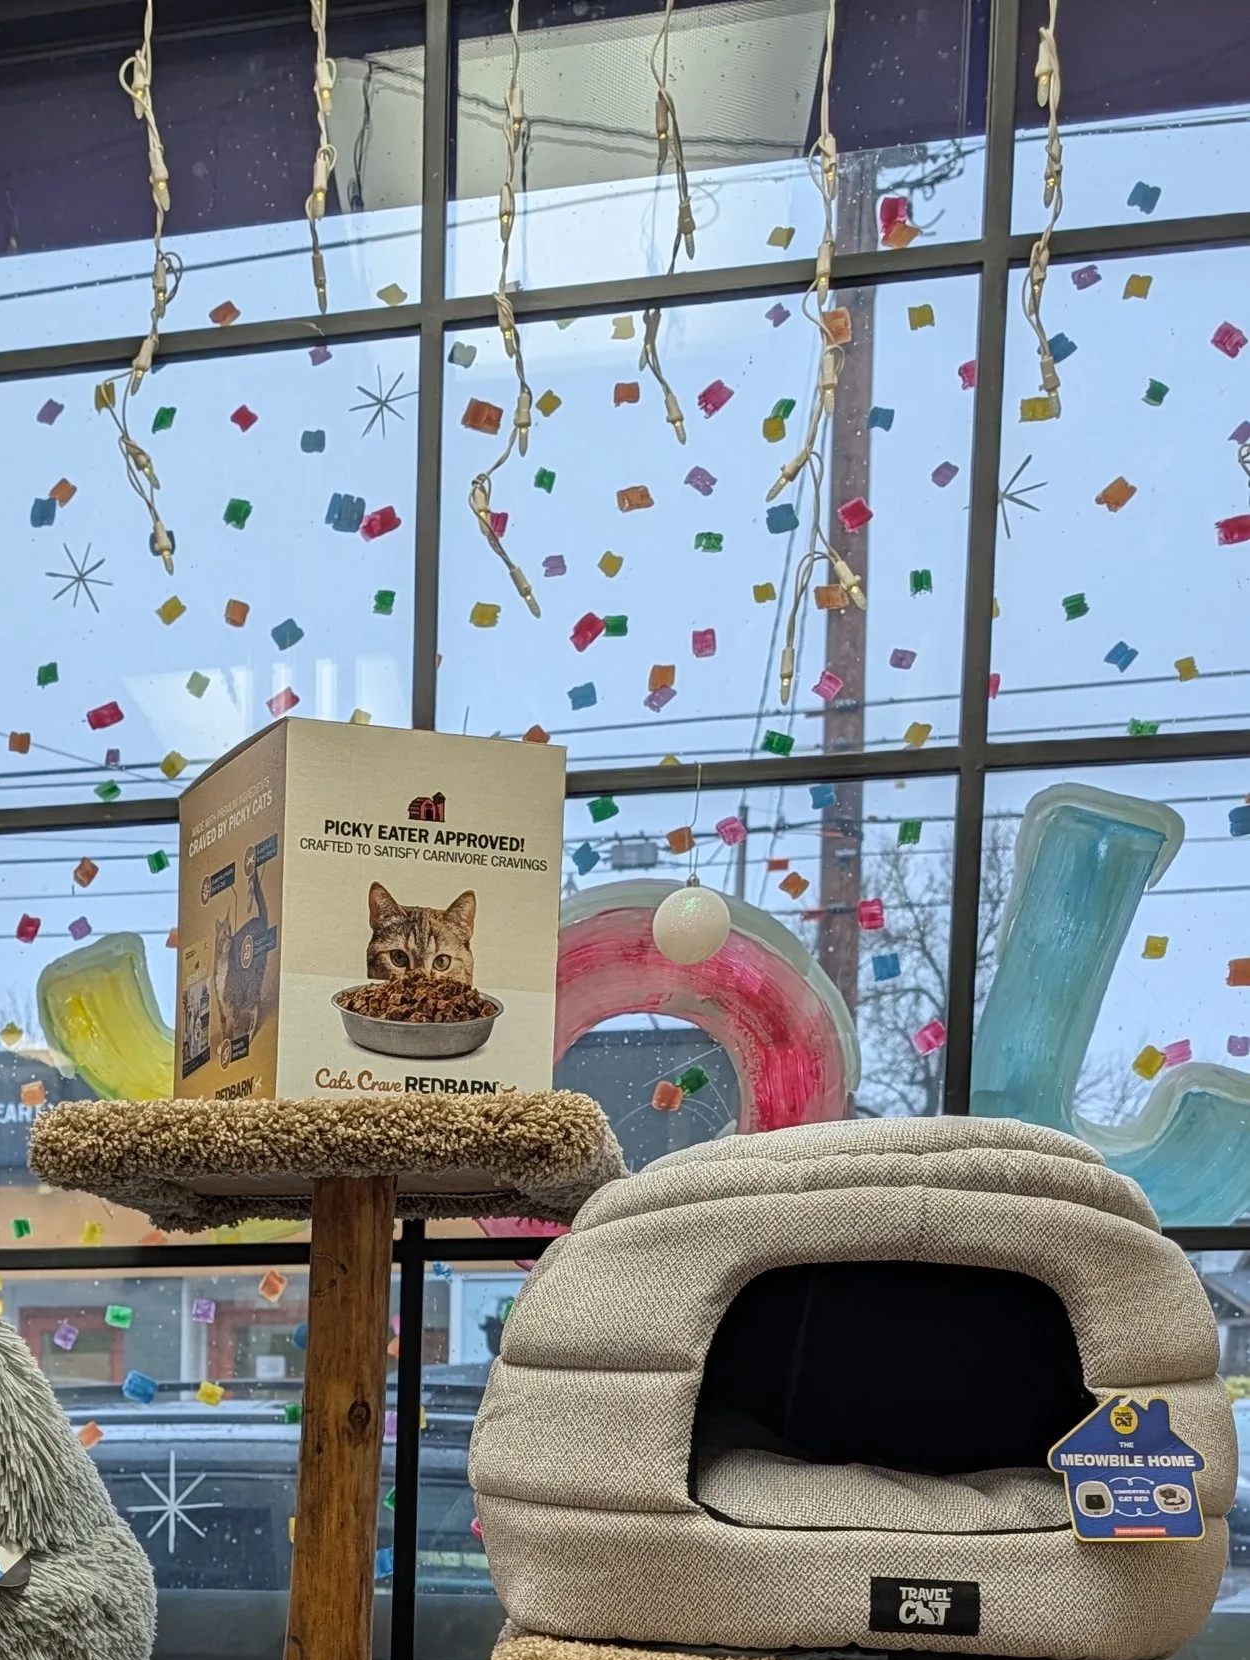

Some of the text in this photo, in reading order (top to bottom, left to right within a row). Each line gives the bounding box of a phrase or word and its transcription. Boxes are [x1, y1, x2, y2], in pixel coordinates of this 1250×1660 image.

[188, 790, 273, 858] CRAVED BY PICKY CATS
[324, 819, 525, 852] PICKY EATER APPROVED!
[300, 838, 548, 872] CRAFTED TO SATISFY CARNIVORE CRAVINGS
[315, 1068, 497, 1096] Cats Crave REDBARN
[1060, 1453, 1196, 1467] MEOWBILE HOME
[899, 1586, 951, 1602] TRAVEL
[898, 1600, 951, 1625] CAT
